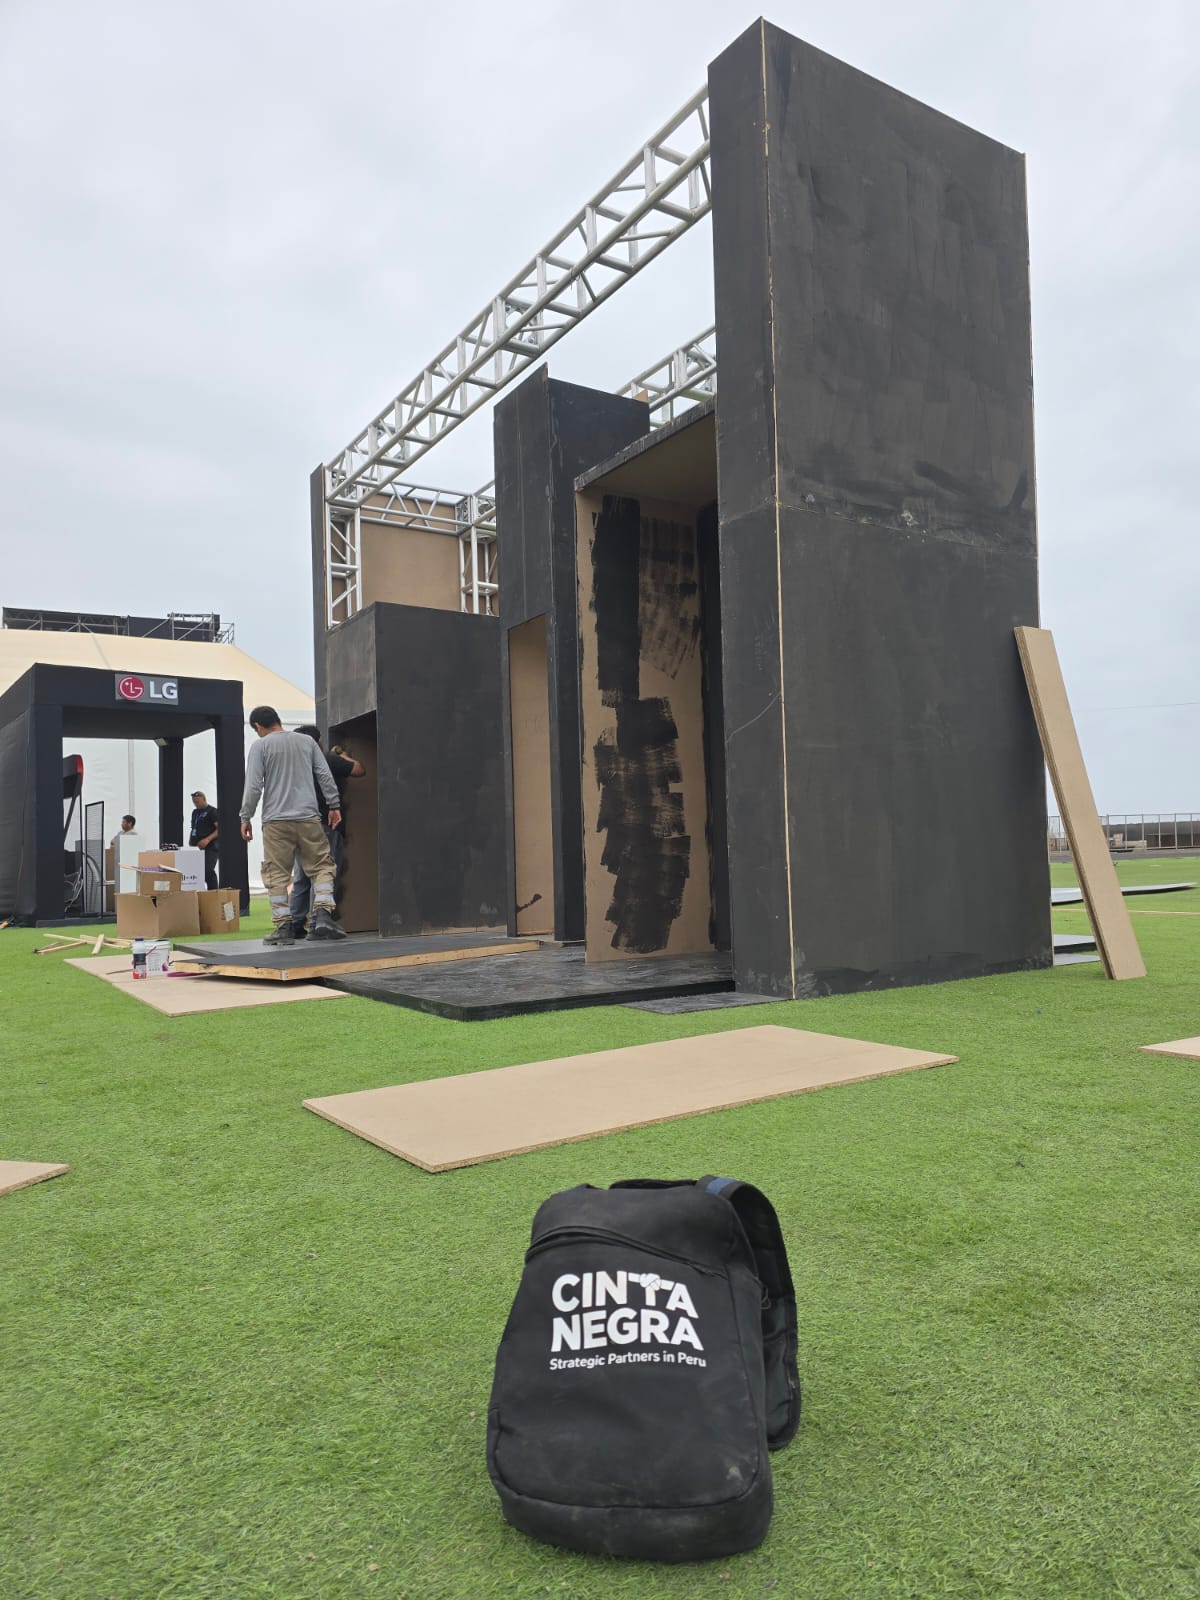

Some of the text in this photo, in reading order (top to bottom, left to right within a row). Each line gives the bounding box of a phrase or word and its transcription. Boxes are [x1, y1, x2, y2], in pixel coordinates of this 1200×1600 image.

[149, 681, 178, 699] LG
[552, 1271, 699, 1319] CINTA
[551, 1308, 704, 1352] NEGRA
[549, 1351, 707, 1370] Strategic Partners in Peru
